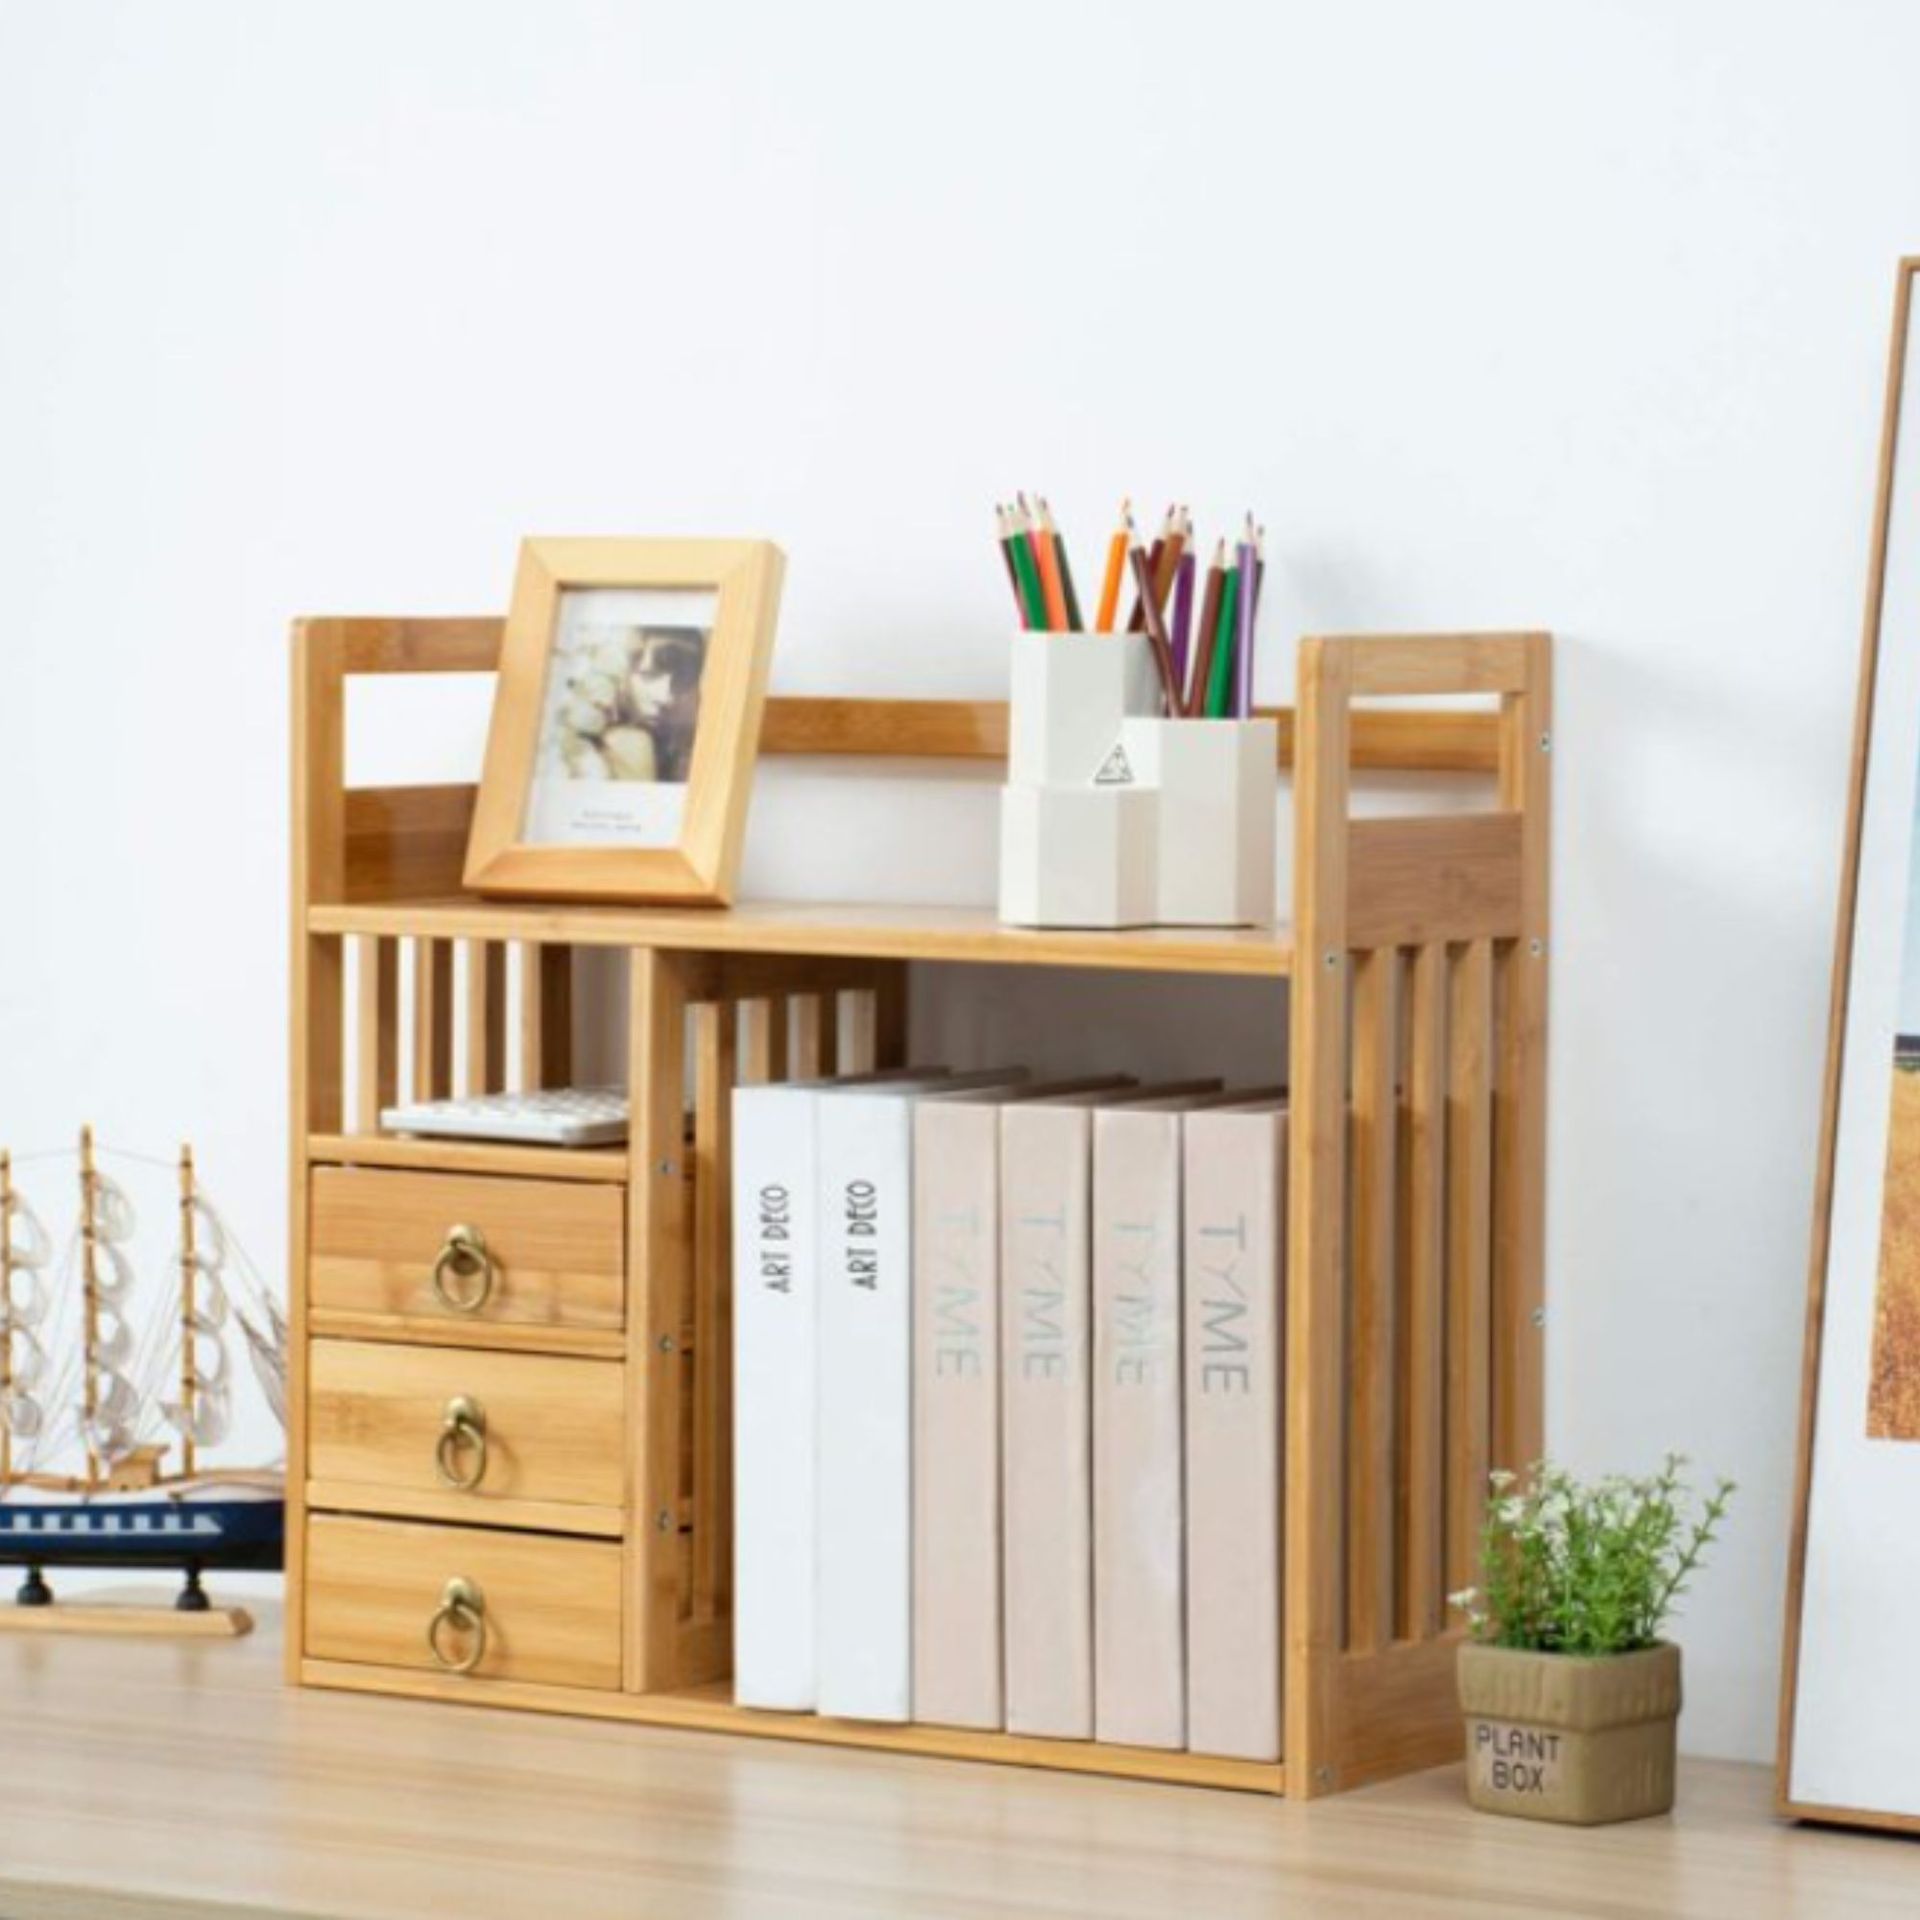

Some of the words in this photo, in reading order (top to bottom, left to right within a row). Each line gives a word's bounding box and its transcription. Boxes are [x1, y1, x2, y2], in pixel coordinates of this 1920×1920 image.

[761, 1185, 789, 1240] DECO
[846, 1181, 877, 1236] DECO
[761, 1250, 790, 1293] ART
[847, 1247, 877, 1290] ART
[936, 1206, 981, 1376] TYME
[1021, 1205, 1065, 1379] TYME
[1115, 1215, 1156, 1385] TYME
[1200, 1215, 1249, 1393] TYME
[1477, 1725, 1560, 1761] PLANT
[1492, 1761, 1544, 1792] BOX
